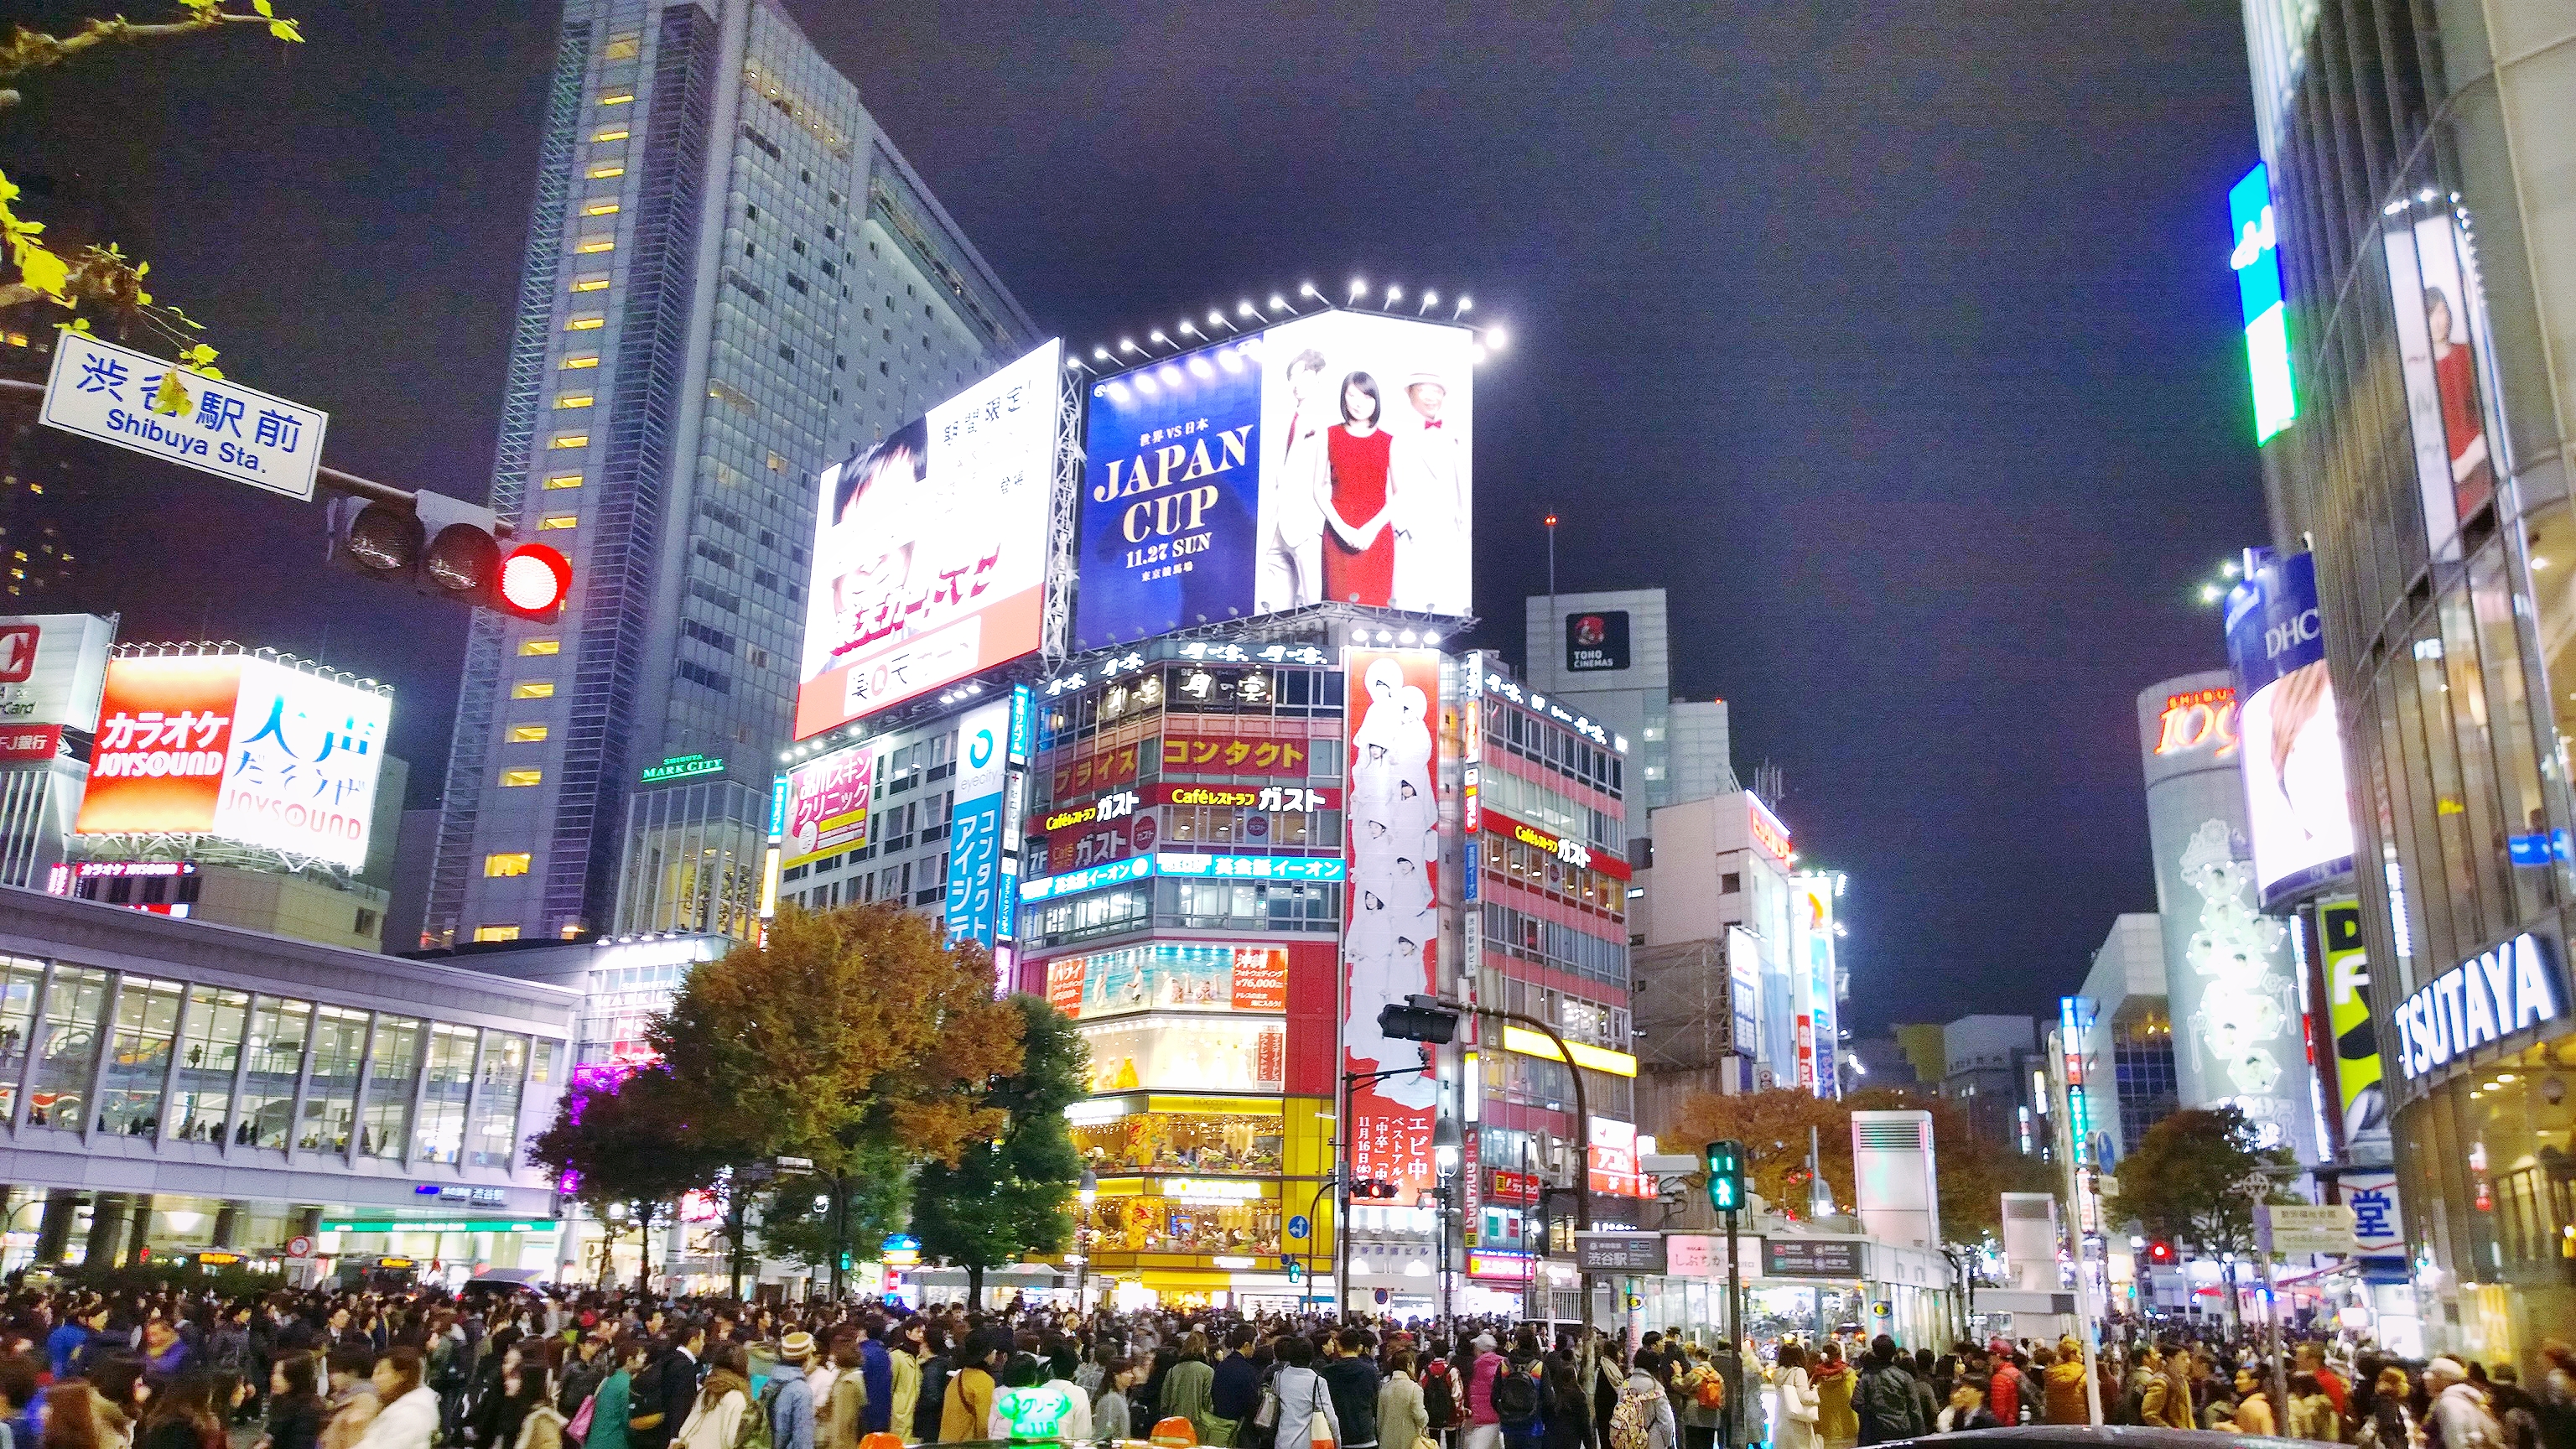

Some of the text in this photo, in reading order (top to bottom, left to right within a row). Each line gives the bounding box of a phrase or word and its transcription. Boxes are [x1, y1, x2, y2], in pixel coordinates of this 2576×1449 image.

[106, 409, 267, 475] Shibuya Sta.
[1140, 418, 1208, 446] 世界 VS 日本
[1093, 423, 1254, 503] JAPAN
[1123, 485, 1218, 543] CUP
[1125, 532, 1213, 569] 11.27 SUN
[1141, 561, 1193, 582] 東京競馬場
[2265, 608, 2320, 660] DHC
[1574, 650, 1602, 660] TOHO
[1574, 658, 1613, 667] CINEMAS
[1180, 673, 1266, 702] 月の宴
[2167, 687, 2236, 709] SHIBU
[100, 710, 229, 749] カラオケ
[94, 750, 224, 777] JOYSOUND
[642, 758, 723, 778] MARK CITY
[663, 754, 703, 766] SHIBUYA
[1055, 750, 1136, 793] プライス
[1164, 740, 1305, 768] コンタクト
[232, 750, 367, 805] だそうぜ
[799, 756, 872, 801] 品川スキン
[960, 769, 998, 793] eyecity
[225, 788, 361, 841] JOYSOUND
[798, 782, 869, 825] クリニック
[1097, 791, 1140, 822] ガスト
[1258, 786, 1326, 813] ガスト
[1030, 849, 1048, 872] 7F
[1075, 830, 1126, 867] ガスト
[1215, 857, 1342, 877] 英会話イーオン
[1557, 839, 1592, 869] ガスト
[948, 814, 978, 942] アイシテ
[974, 809, 996, 938] コンタクト
[2395, 932, 2555, 1080] TSUTAYA
[1374, 1116, 1389, 1181] 「中卒」「中
[1407, 1117, 1430, 1181] エビ中
[2350, 1189, 2395, 1237] 堂
[1587, 1252, 1628, 1265] 渋谷駅
